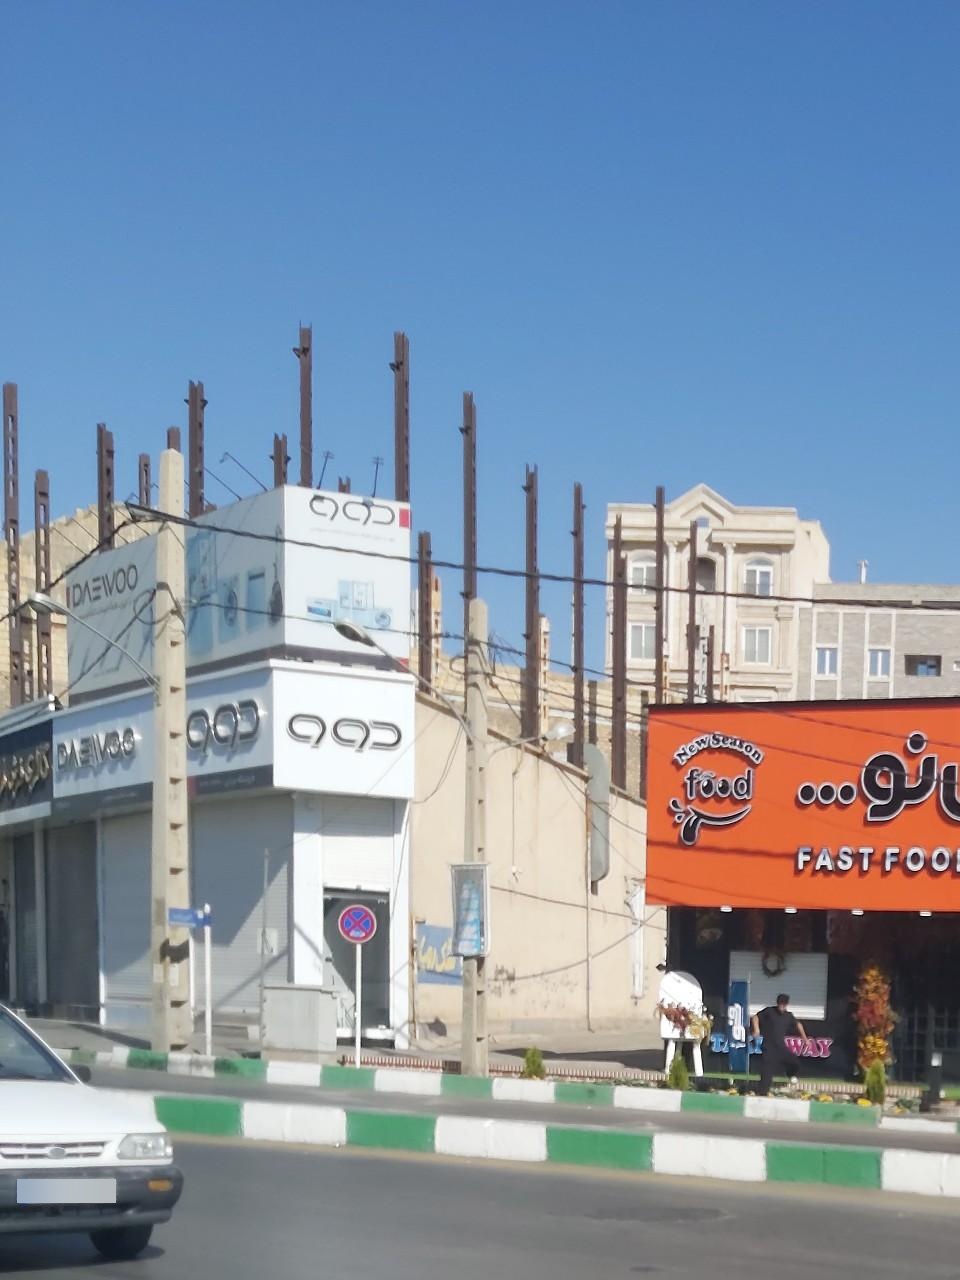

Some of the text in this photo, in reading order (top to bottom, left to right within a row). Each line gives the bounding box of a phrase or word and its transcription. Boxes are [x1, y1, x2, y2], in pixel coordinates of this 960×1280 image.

[72, 564, 138, 607] DAEWOO
[57, 727, 136, 769] DAEWOO
[287, 713, 402, 753] دوو
[674, 731, 764, 765] New Season
[684, 767, 753, 800] food
[796, 846, 874, 872] FAST
